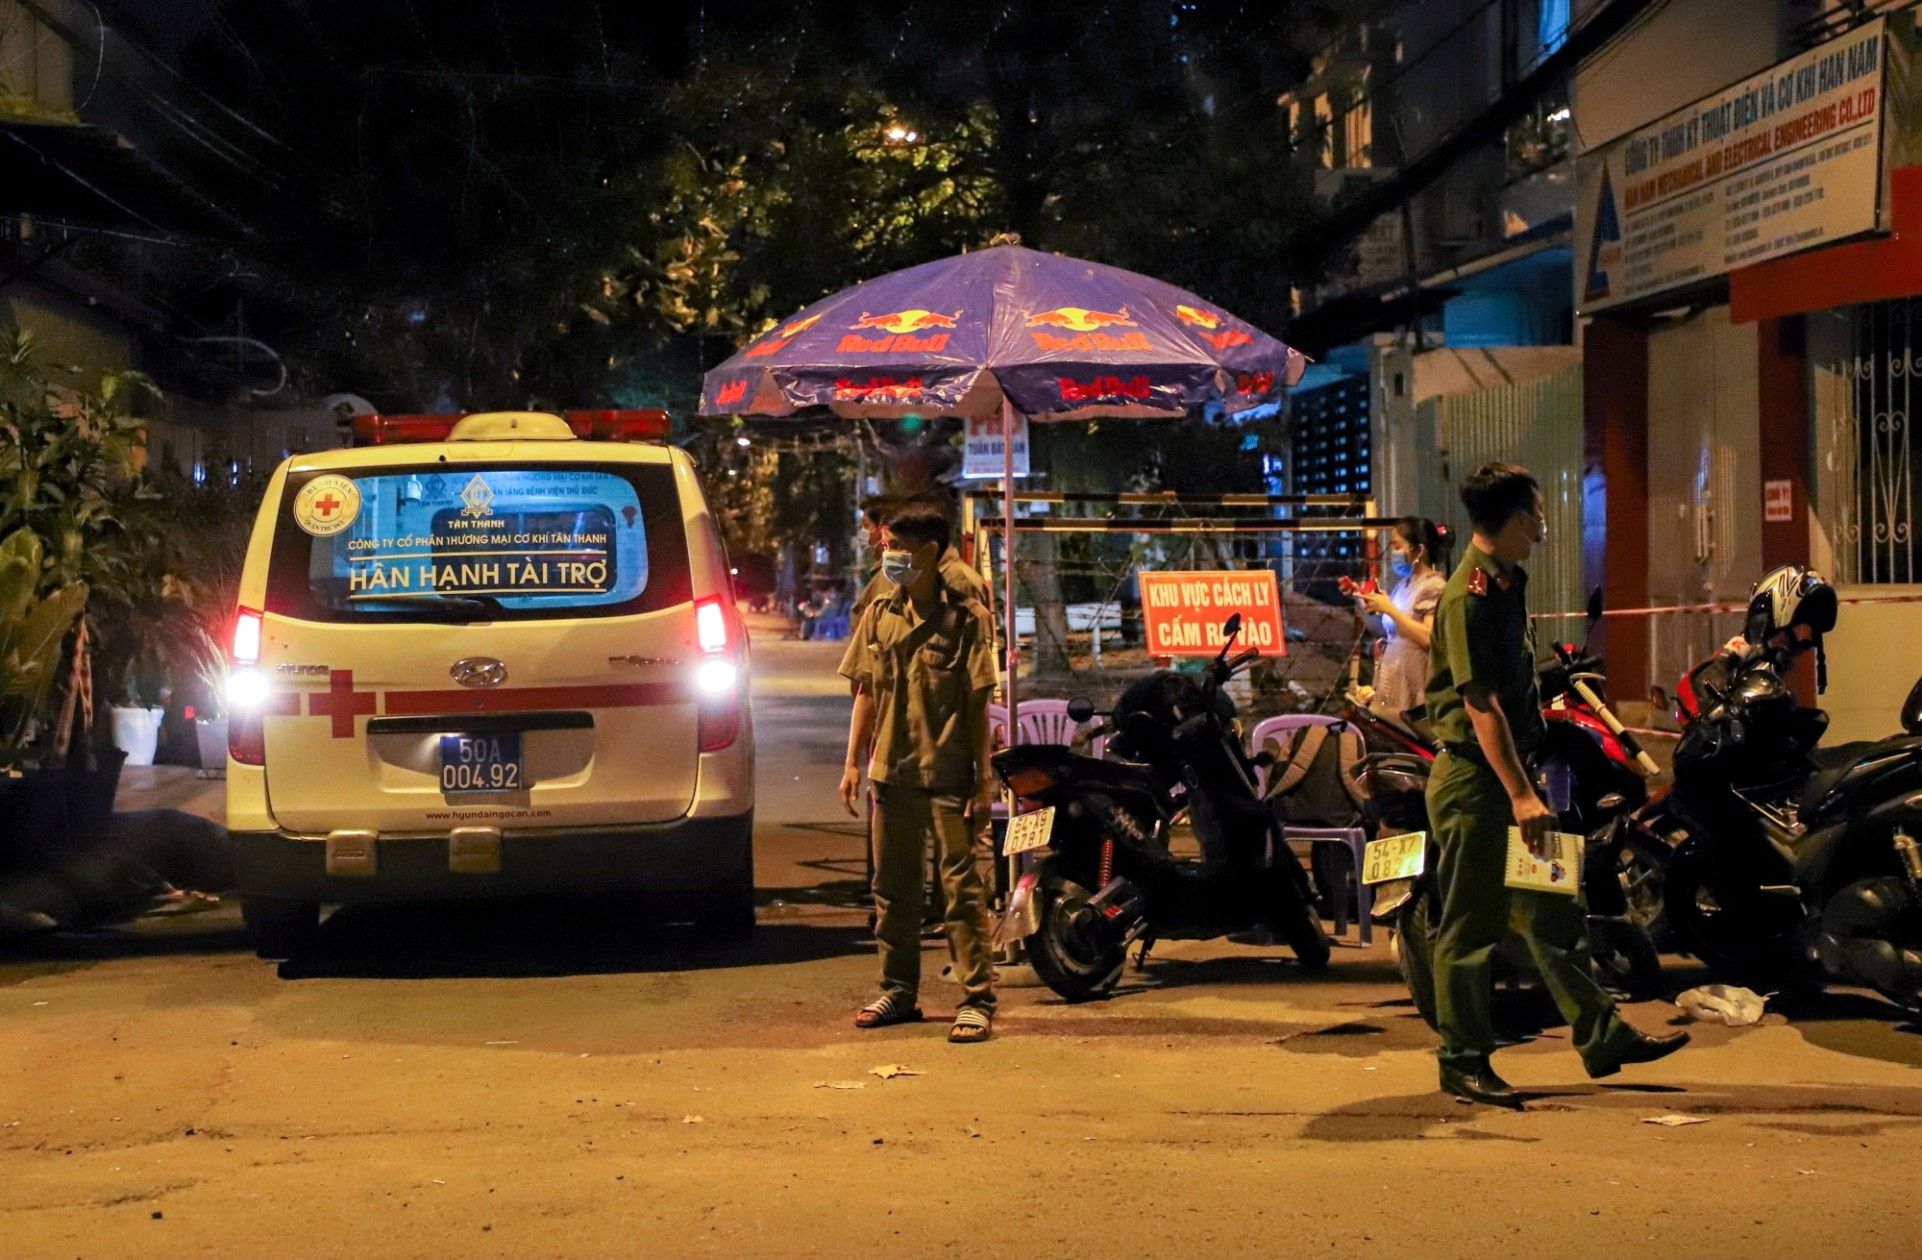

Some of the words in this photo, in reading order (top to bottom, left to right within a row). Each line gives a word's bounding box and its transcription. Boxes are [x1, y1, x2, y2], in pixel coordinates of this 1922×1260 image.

[1848, 36, 1878, 82] NAM
[1724, 128, 1772, 170] ELECTRICAL
[1775, 103, 1837, 151] ENGINEERING
[472, 519, 505, 528] THANH
[348, 537, 380, 550] CÔNG
[382, 538, 395, 548] TY
[446, 533, 489, 546] THƯƠNG
[491, 534, 511, 546] MẠI
[514, 532, 530, 544] CƠ
[532, 530, 549, 544] KHÍ
[551, 531, 571, 544] TÂN
[573, 533, 607, 544] THANH
[350, 562, 410, 591] HÂN
[420, 563, 499, 591] HẠNH
[506, 556, 548, 585] TÀI
[557, 559, 607, 588] TRỢ
[1150, 583, 1178, 607] KHU
[1181, 581, 1210, 612] VỰC
[1213, 577, 1252, 607] CÁCH
[1254, 582, 1269, 606] LY
[1158, 615, 1202, 647] CẤM
[459, 738, 501, 763] 50A
[443, 763, 518, 789] 004.92
[426, 809, 551, 821] www.hyundaingocan.com
[1373, 835, 1417, 860] 54-X7
